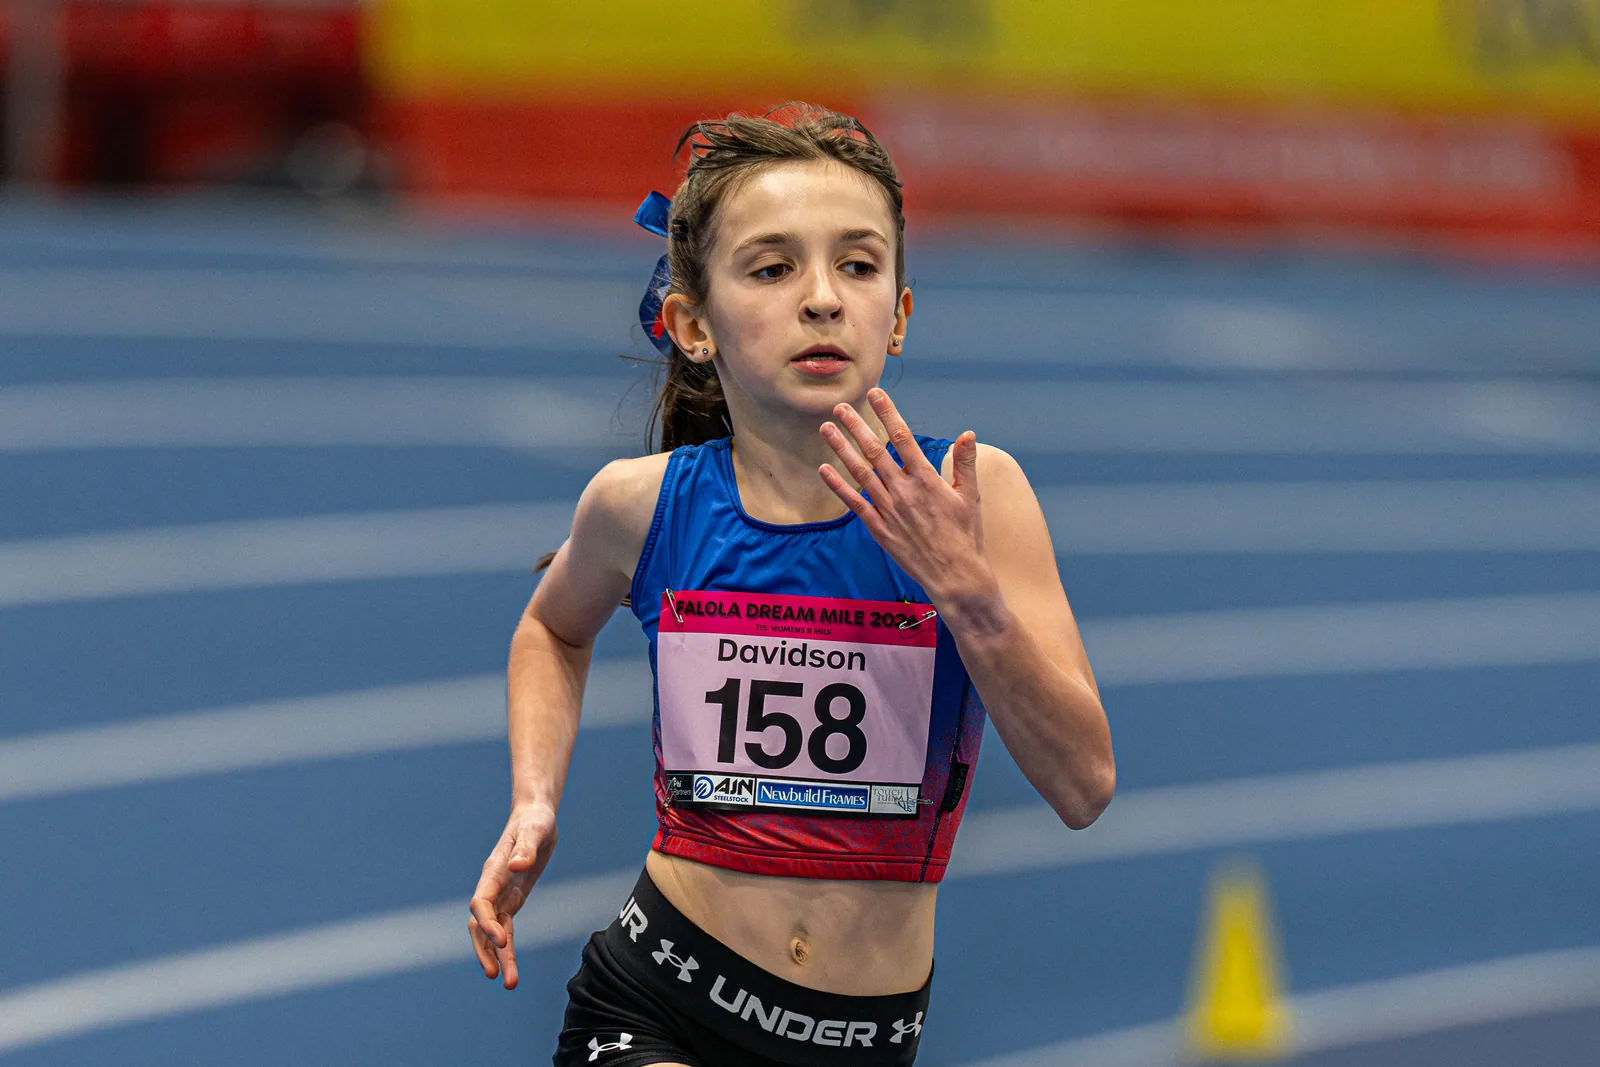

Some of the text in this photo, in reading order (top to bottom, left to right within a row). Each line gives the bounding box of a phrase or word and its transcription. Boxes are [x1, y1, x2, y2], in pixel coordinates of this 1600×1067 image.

[675, 600, 741, 616] FALOLA
[746, 603, 814, 622] DREAM
[820, 608, 864, 625] MILE
[771, 625, 805, 634] WOMENS
[717, 638, 866, 671] Davidson
[705, 678, 867, 774] 158
[714, 778, 753, 796] AJN
[822, 789, 865, 806] FRAMES
[714, 795, 749, 803] STEELSTOCK
[709, 975, 878, 1047] UNDER
